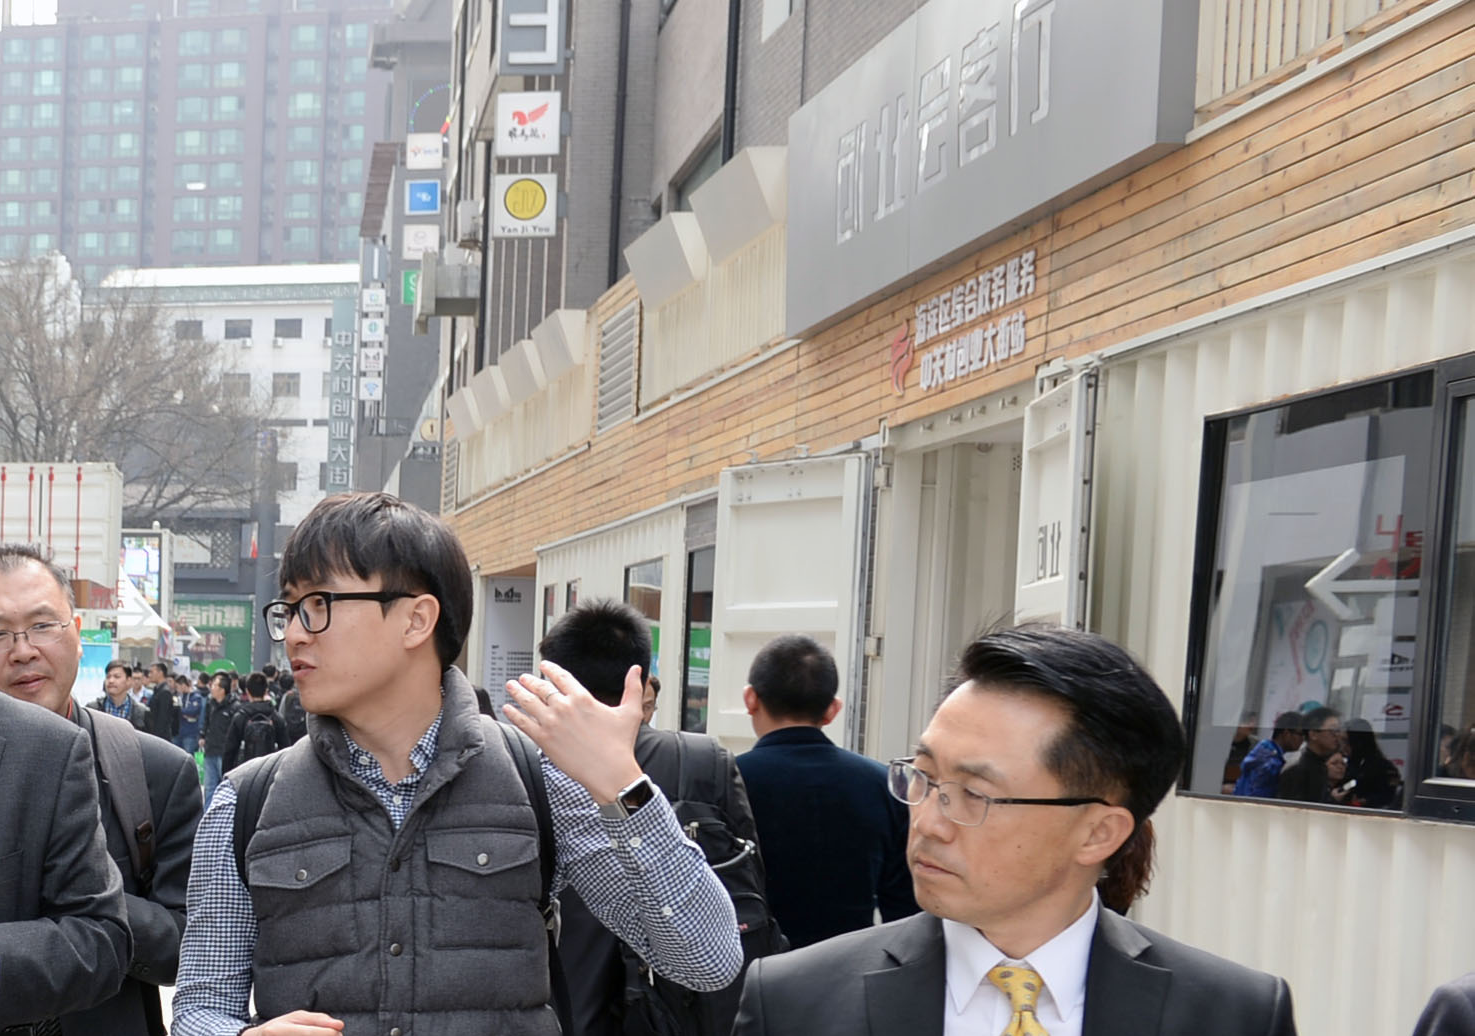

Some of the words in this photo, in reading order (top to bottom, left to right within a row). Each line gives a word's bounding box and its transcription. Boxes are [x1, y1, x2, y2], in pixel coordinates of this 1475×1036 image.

[914, 249, 1037, 348] 海淀区综合政务服务
[920, 309, 1027, 392] 中关村创业大街站
[329, 330, 353, 486] 中关村创业大街
